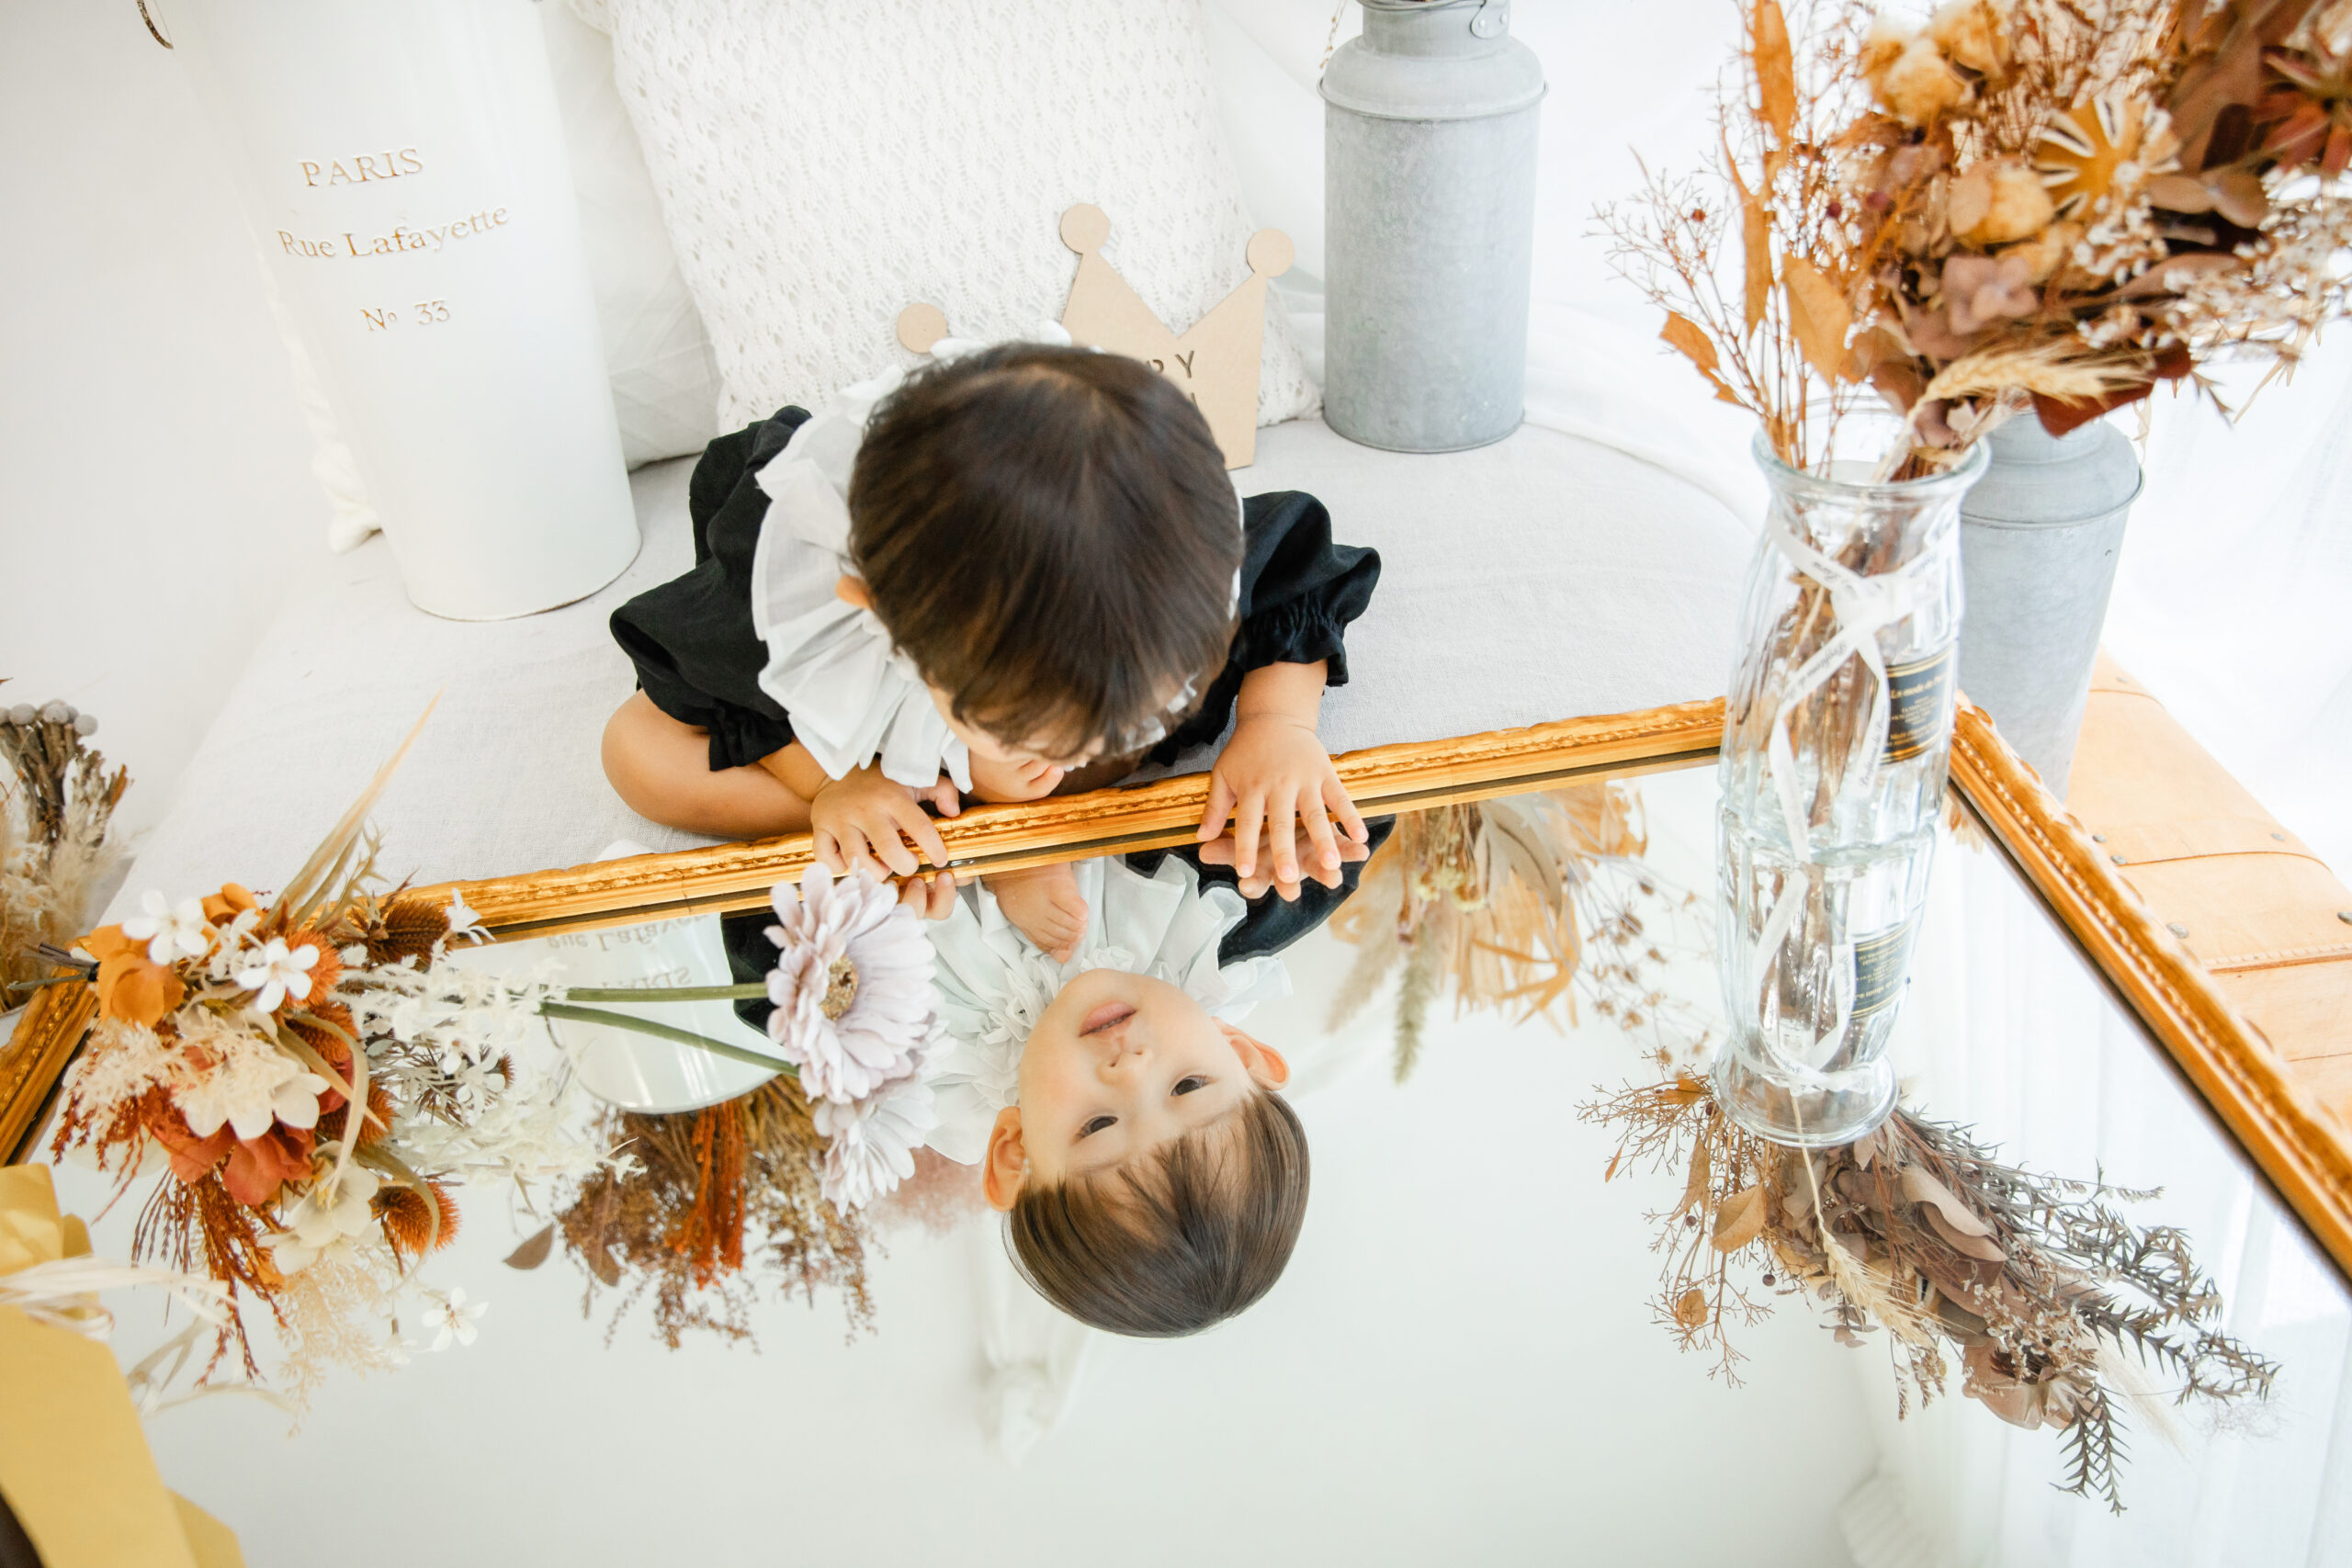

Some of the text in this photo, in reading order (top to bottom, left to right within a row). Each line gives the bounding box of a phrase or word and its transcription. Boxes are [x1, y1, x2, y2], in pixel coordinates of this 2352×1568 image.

[300, 147, 424, 187] PARIS
[276, 206, 509, 258] Rue Lafayette
[413, 299, 451, 325] 33
